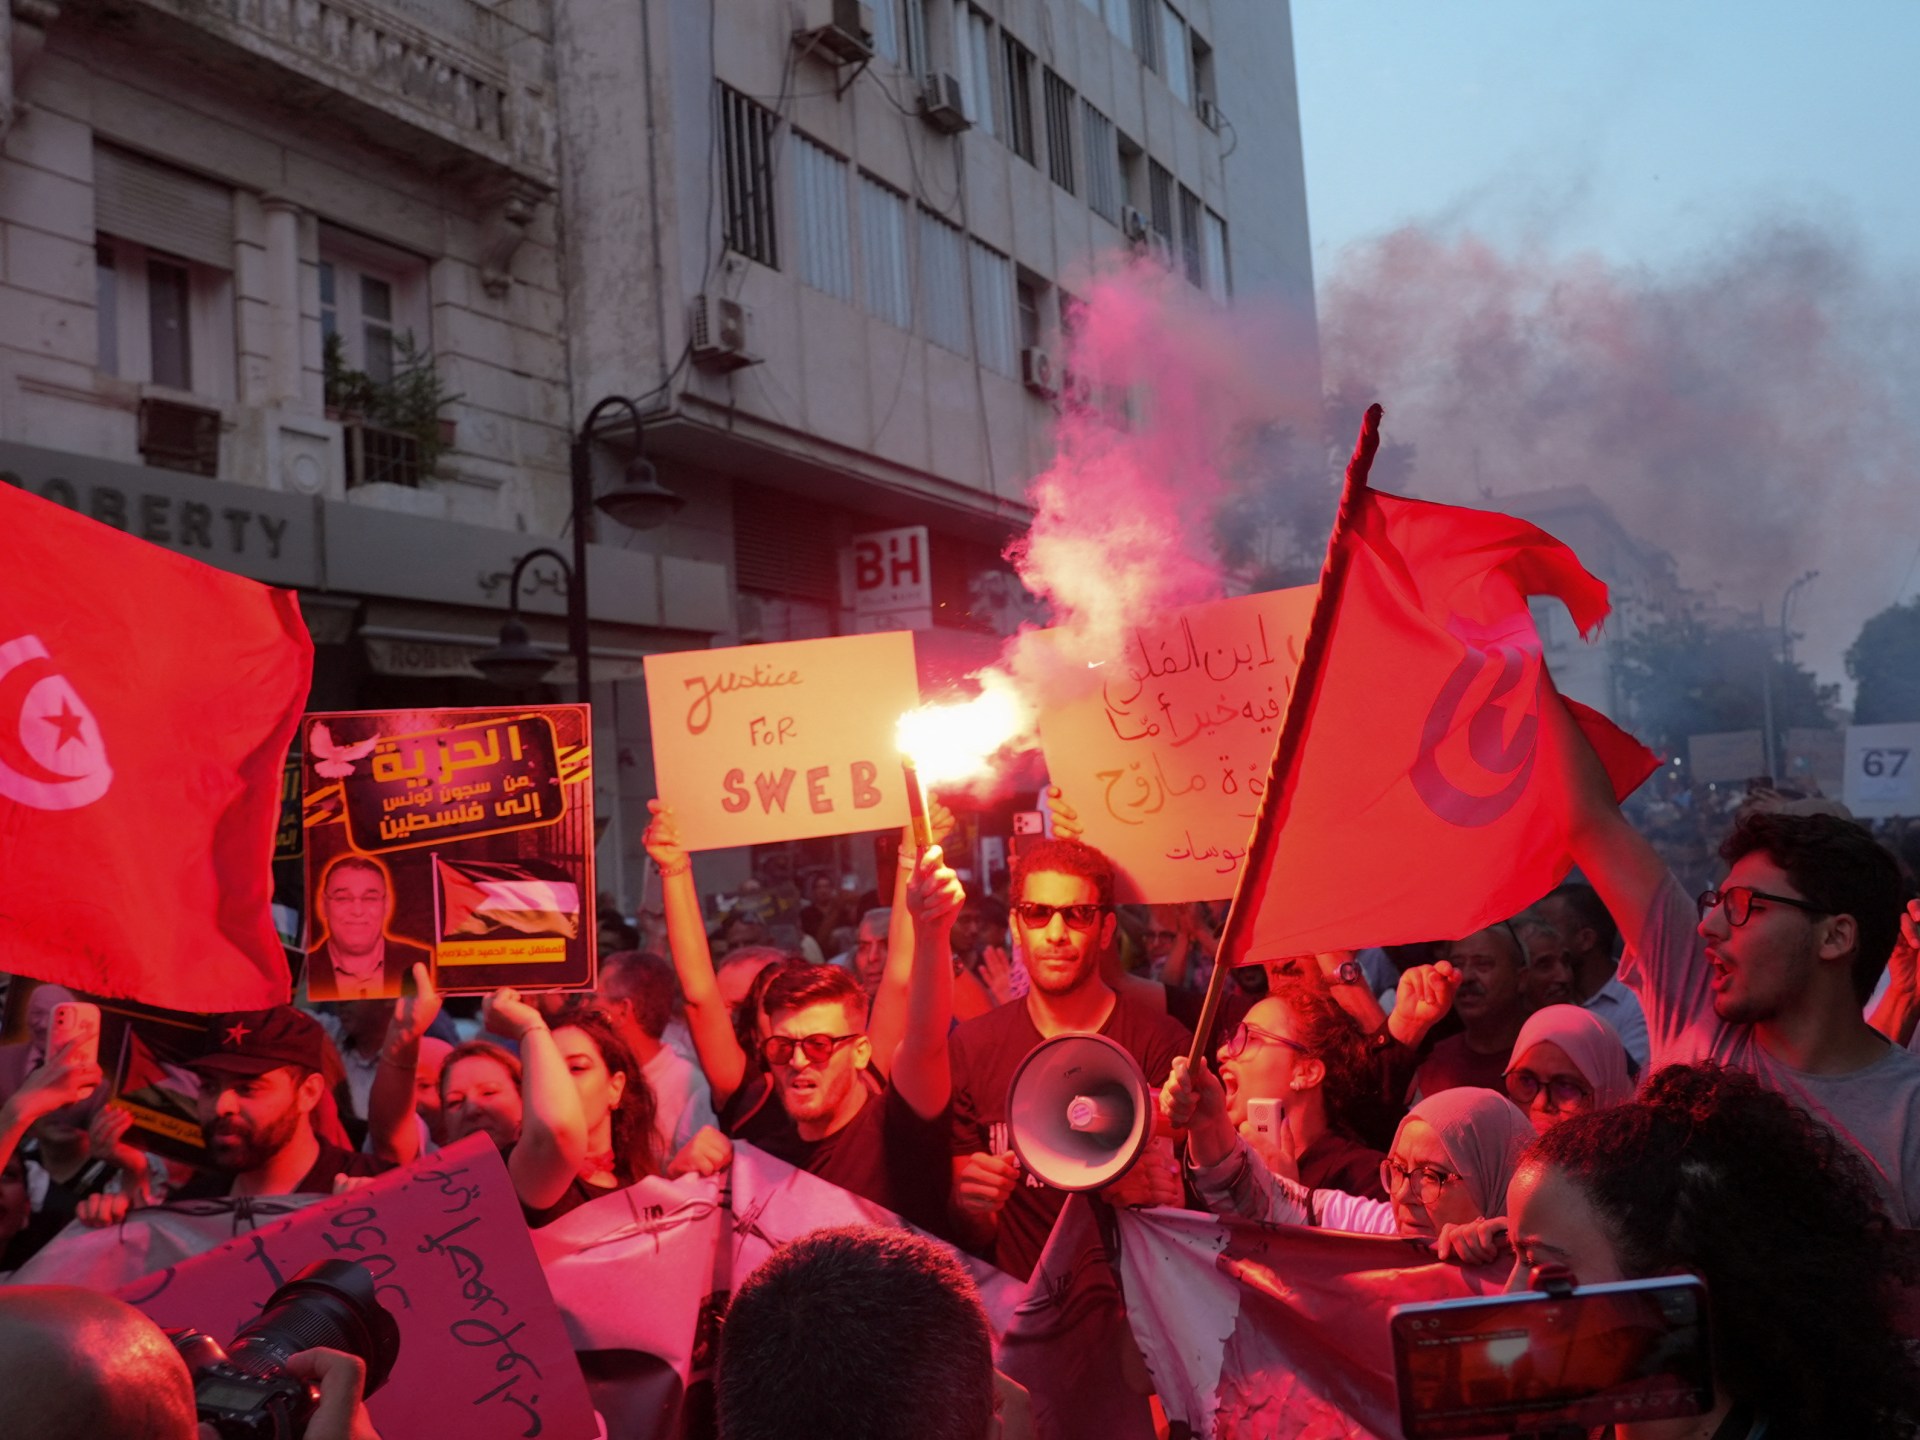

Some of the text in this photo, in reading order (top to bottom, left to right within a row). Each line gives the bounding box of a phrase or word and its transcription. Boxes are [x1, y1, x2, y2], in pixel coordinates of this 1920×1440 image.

[0, 471, 288, 560] OBERTY
[855, 534, 921, 591] BH
[684, 664, 804, 736] Justice
[1170, 694, 1239, 748] خير
[371, 725, 524, 787] الحرية
[1863, 749, 1910, 777] 67
[383, 774, 529, 811] من سجون تونس
[721, 760, 883, 815] SWEB
[379, 792, 542, 841] إلى فلسطين
[417, 1217, 510, 1317] أحمد
[449, 1317, 543, 1438] صواب
